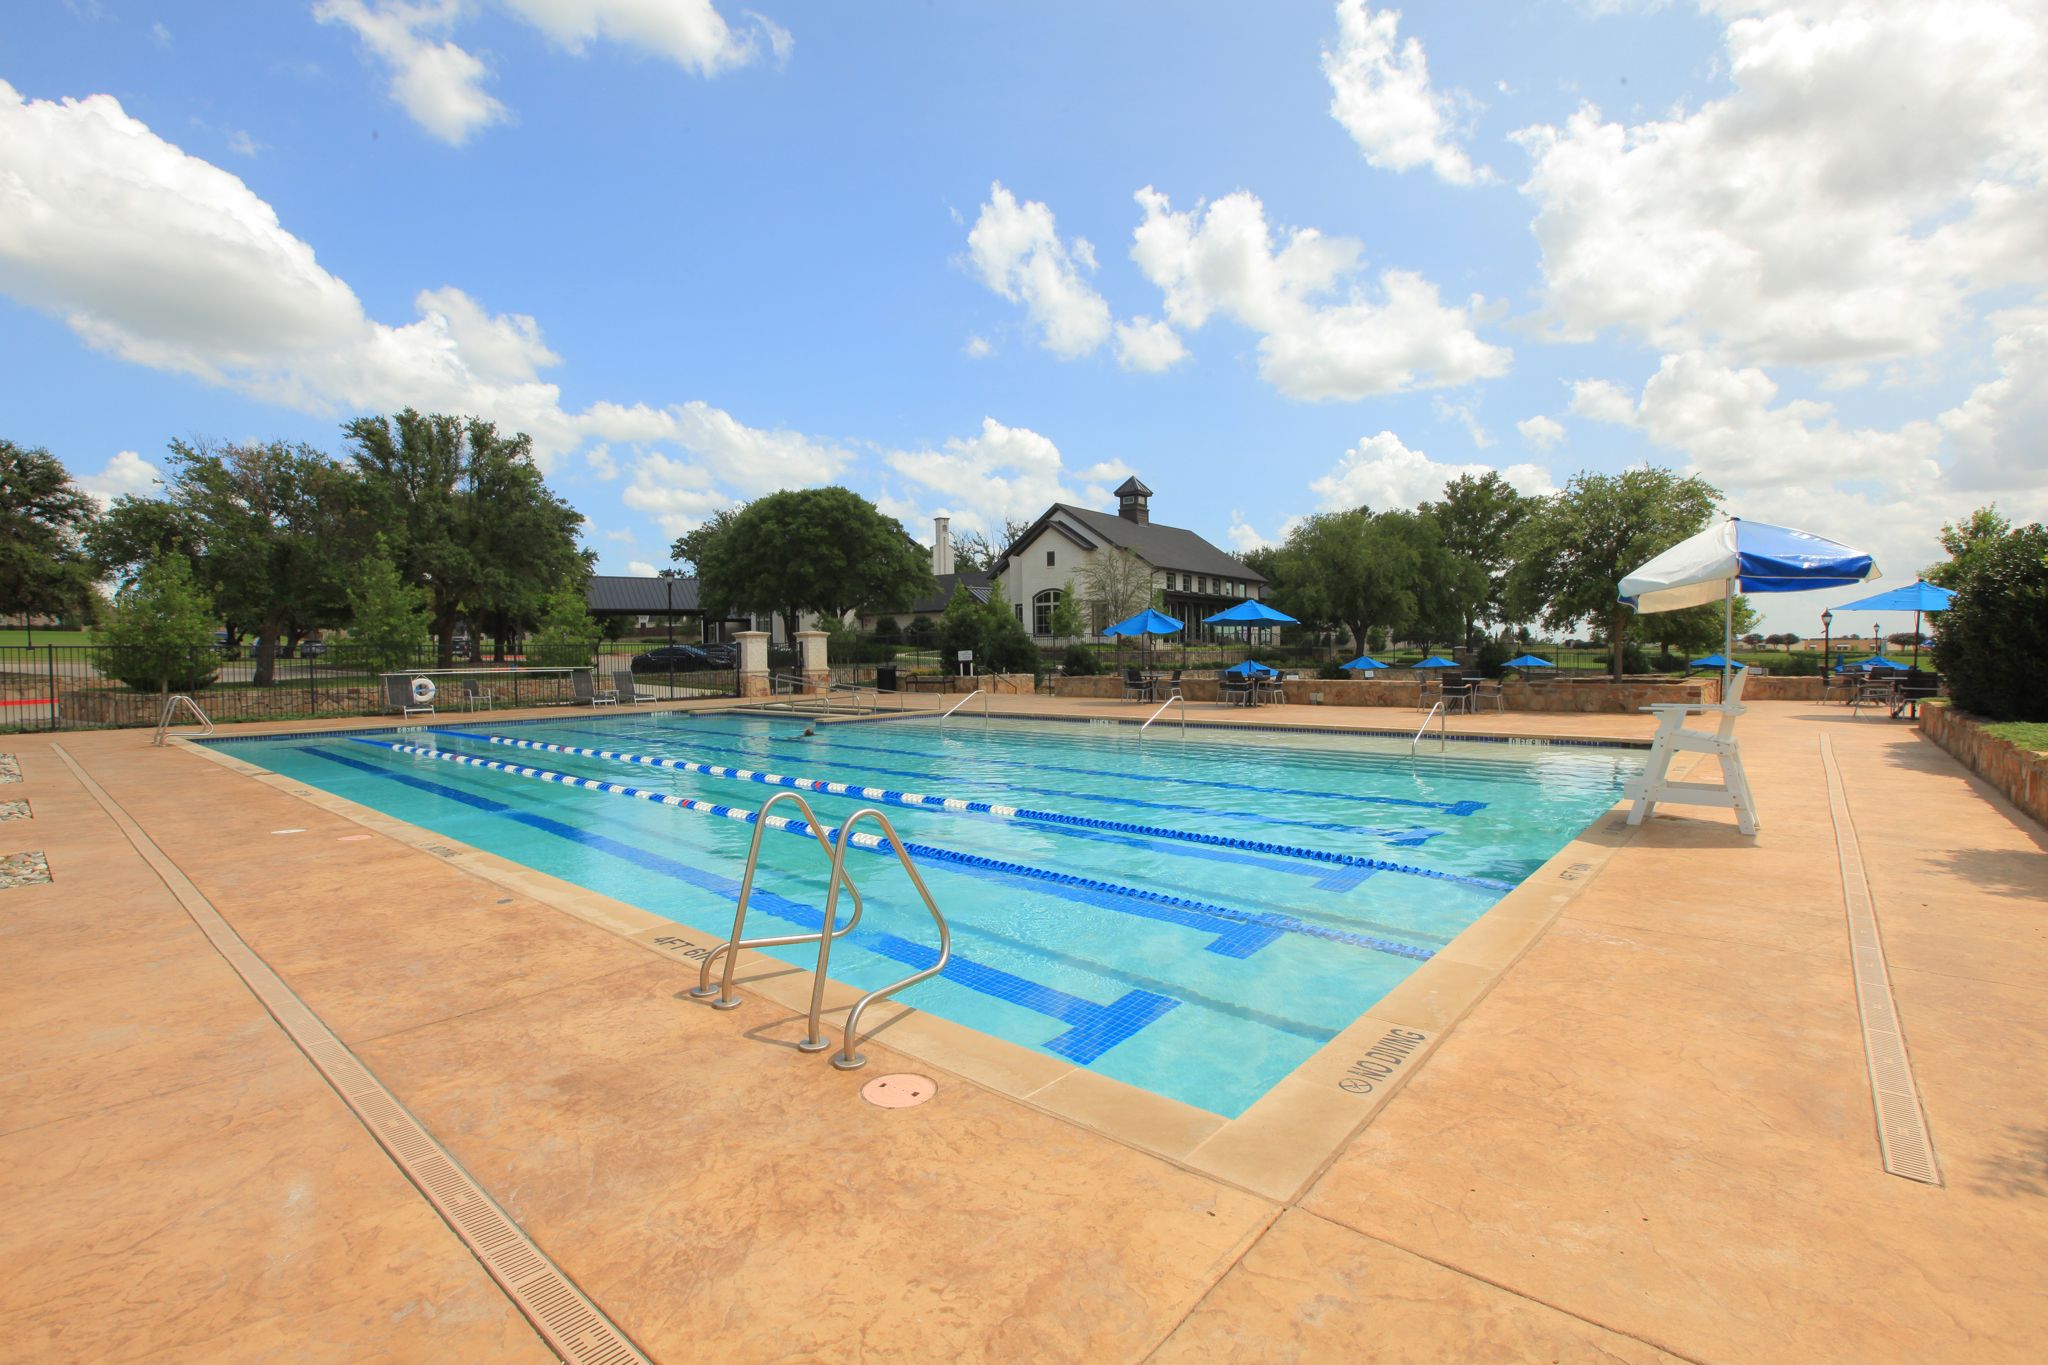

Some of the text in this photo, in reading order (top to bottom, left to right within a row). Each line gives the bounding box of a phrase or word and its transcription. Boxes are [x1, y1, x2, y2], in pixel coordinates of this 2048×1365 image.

[654, 936, 696, 950] 4FT
[1346, 1028, 1426, 1082] NO DIVING
